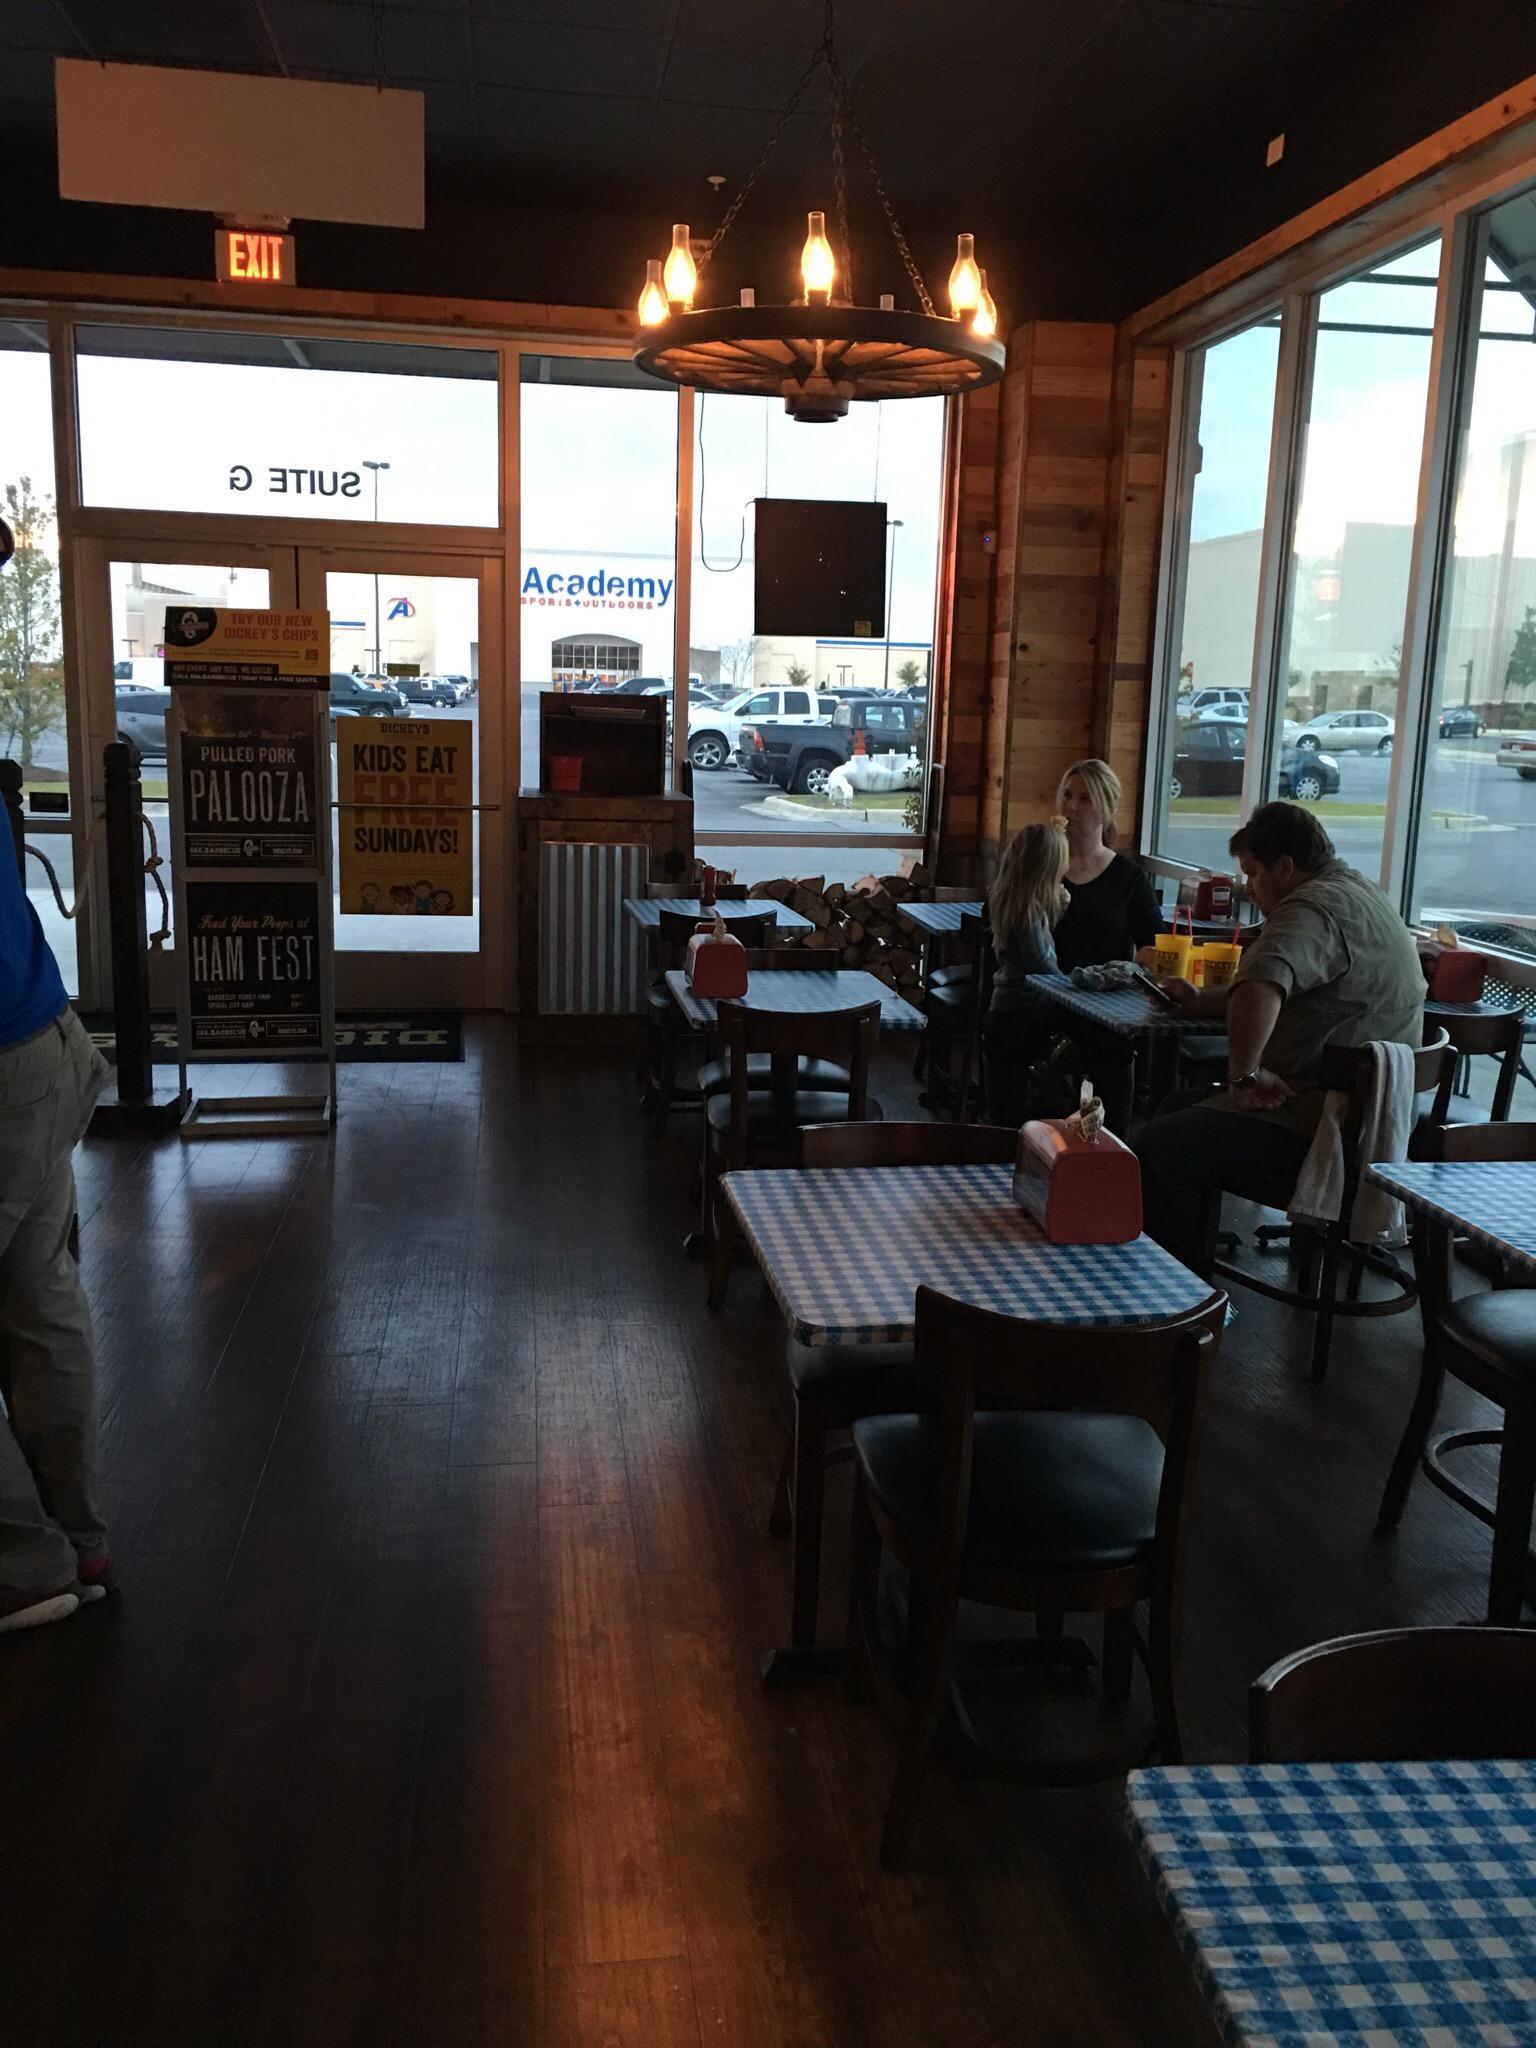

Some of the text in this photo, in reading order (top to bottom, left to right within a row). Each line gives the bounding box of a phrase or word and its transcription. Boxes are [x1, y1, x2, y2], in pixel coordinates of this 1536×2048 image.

[228, 232, 283, 280] EXIT
[522, 566, 674, 607] Academy
[223, 627, 320, 642] DICKEY'S CHIPS
[231, 613, 313, 628] TRY OUR NEW
[380, 722, 431, 735] DICKEY'S
[200, 745, 296, 764] PULLED PORK
[353, 743, 458, 774] KIDS EAT
[189, 769, 309, 824] PALOOZA
[354, 775, 459, 827] FREE
[354, 827, 459, 855] SUNDAYS!
[198, 914, 229, 930] Feed
[231, 914, 260, 933] Your
[261, 915, 294, 933] Peeps
[193, 935, 315, 982] HAM FEST
